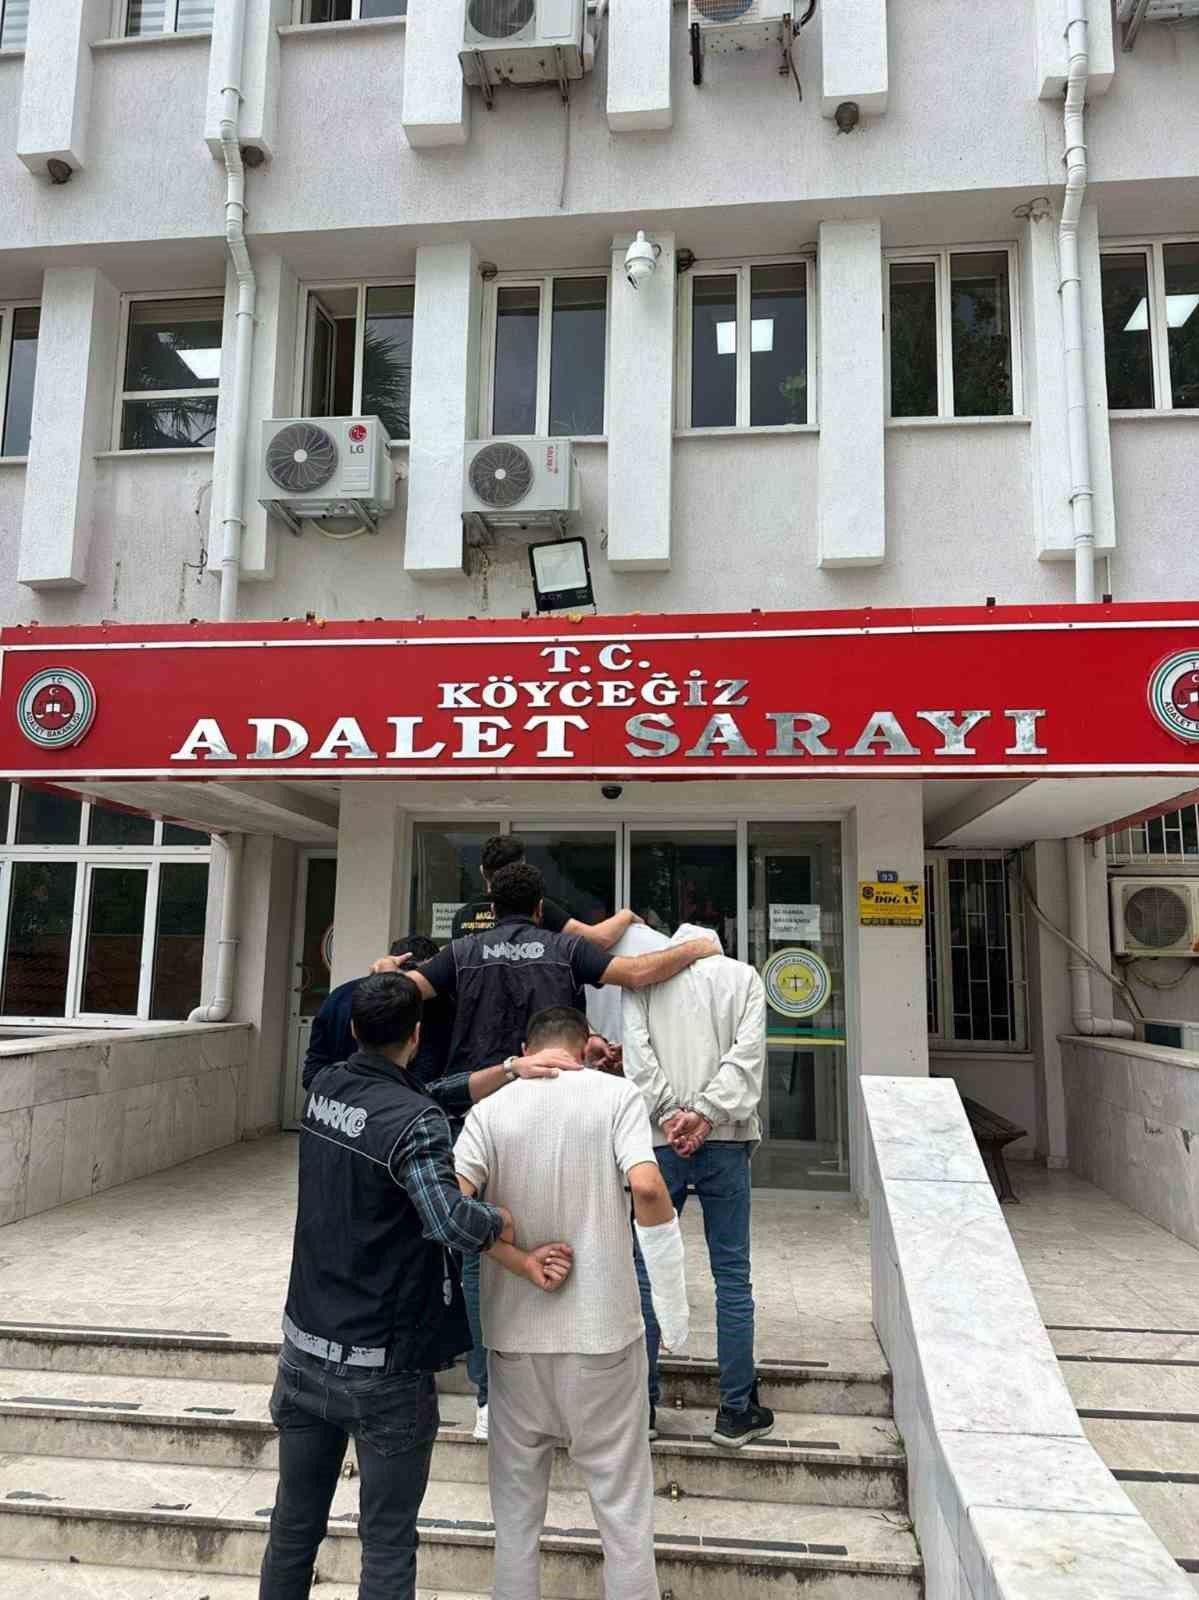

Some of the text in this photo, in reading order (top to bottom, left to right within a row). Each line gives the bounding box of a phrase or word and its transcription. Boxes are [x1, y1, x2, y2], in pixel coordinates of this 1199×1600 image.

[350, 444, 364, 455] LG
[436, 669, 750, 709] KÖYCEĞİZ
[170, 709, 1049, 760] ADALET SARAYI
